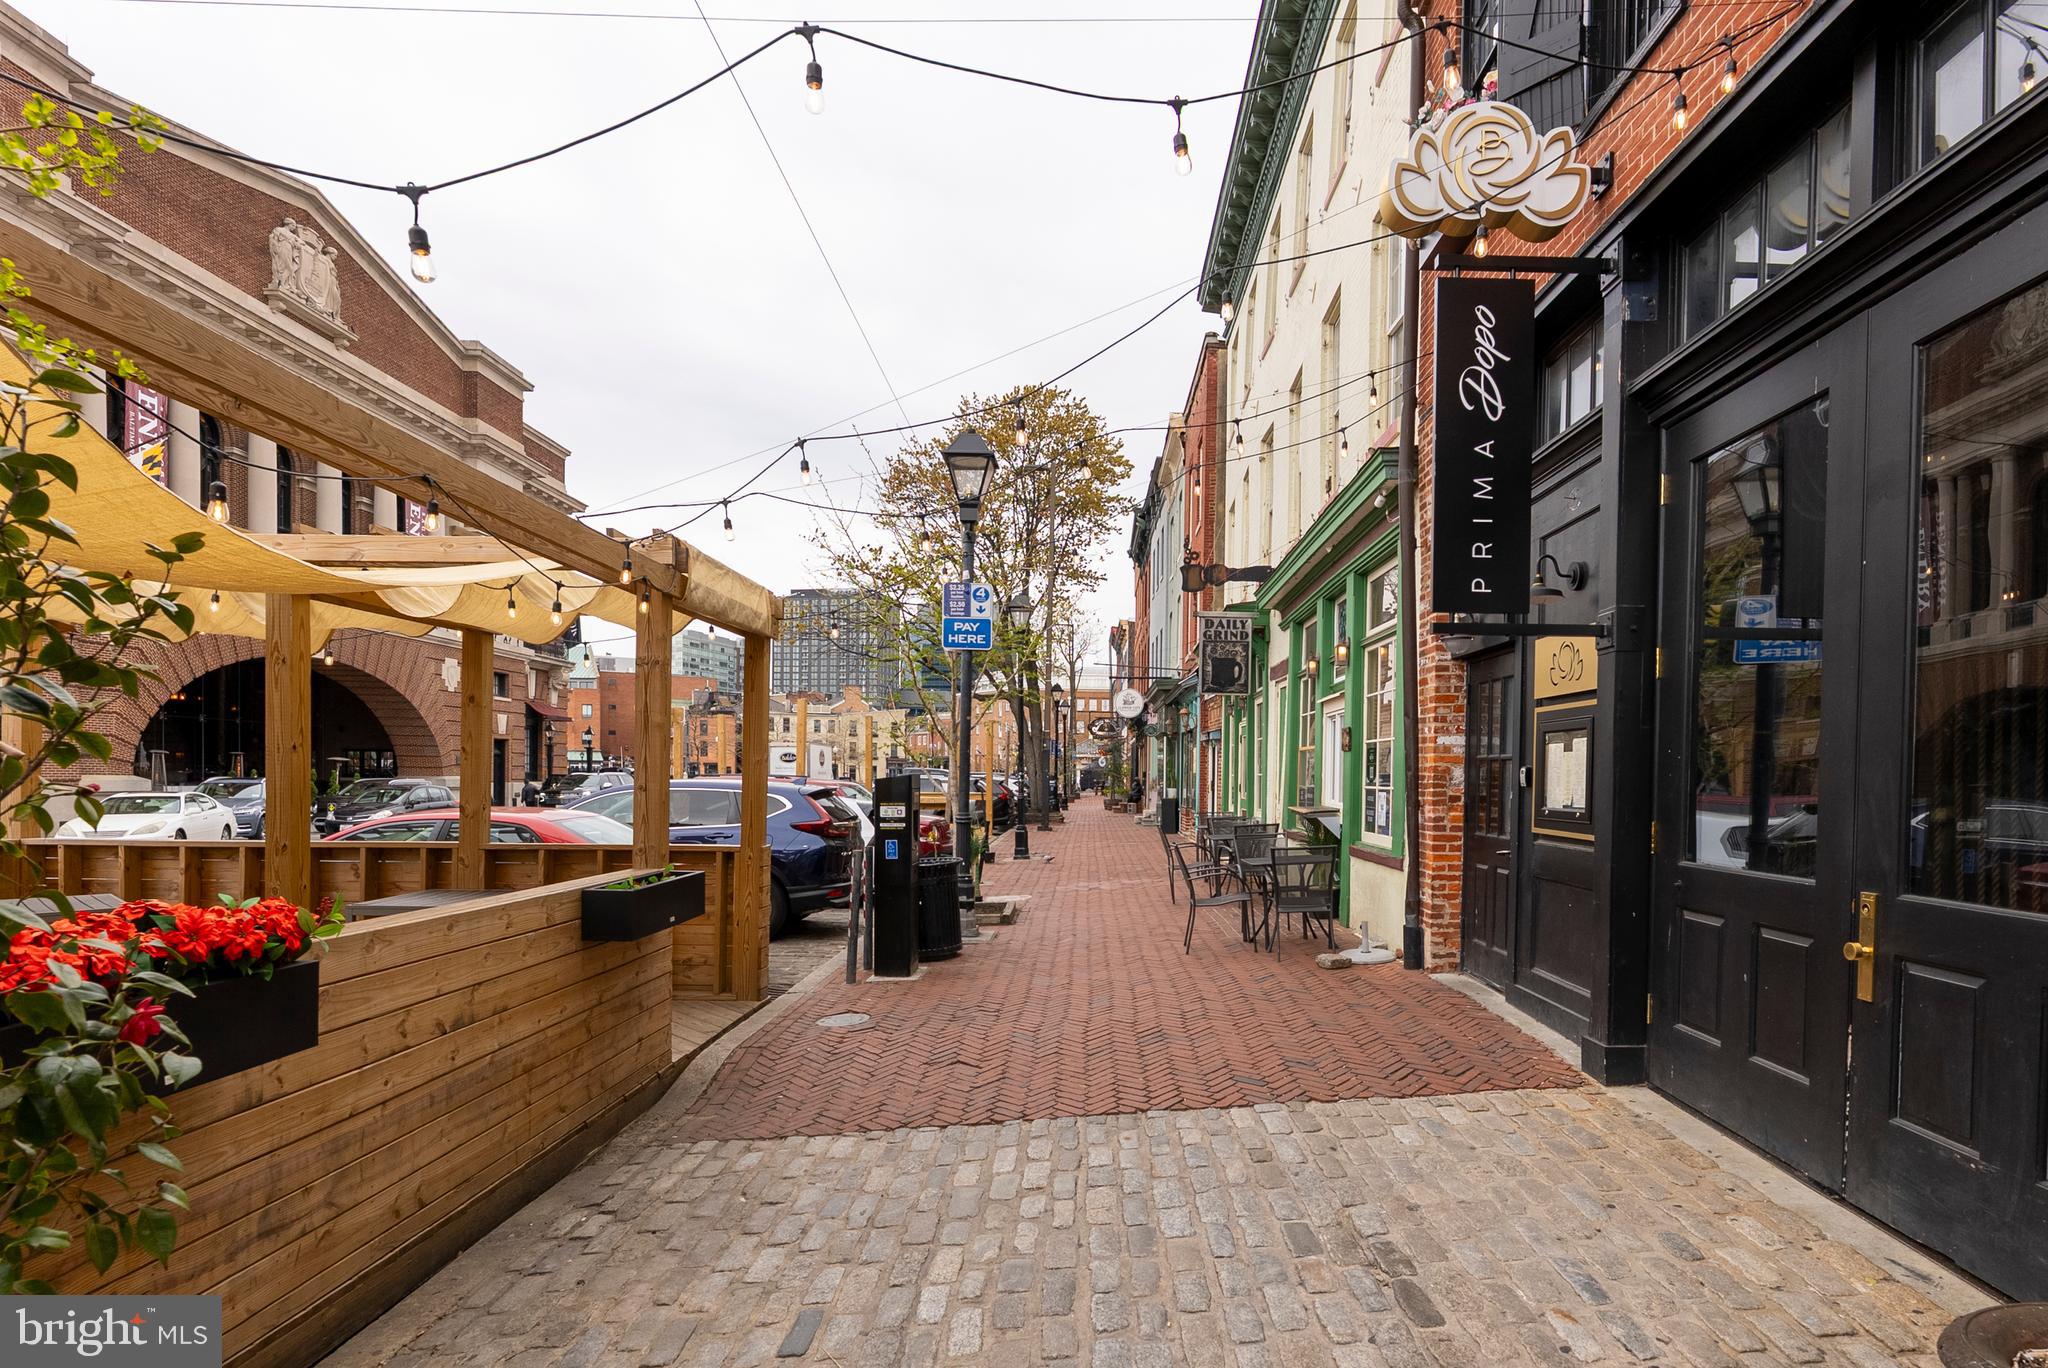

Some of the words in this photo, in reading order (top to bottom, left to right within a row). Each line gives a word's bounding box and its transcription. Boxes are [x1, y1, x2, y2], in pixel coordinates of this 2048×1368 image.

[1459, 304, 1511, 422] Dopo
[1471, 440, 1495, 593] PRIMA
[976, 588, 986, 597] 4
[954, 622, 980, 631] PAY
[1204, 619, 1248, 630] DAILY
[948, 634, 986, 643] HERE
[1203, 630, 1249, 641] GRIND
